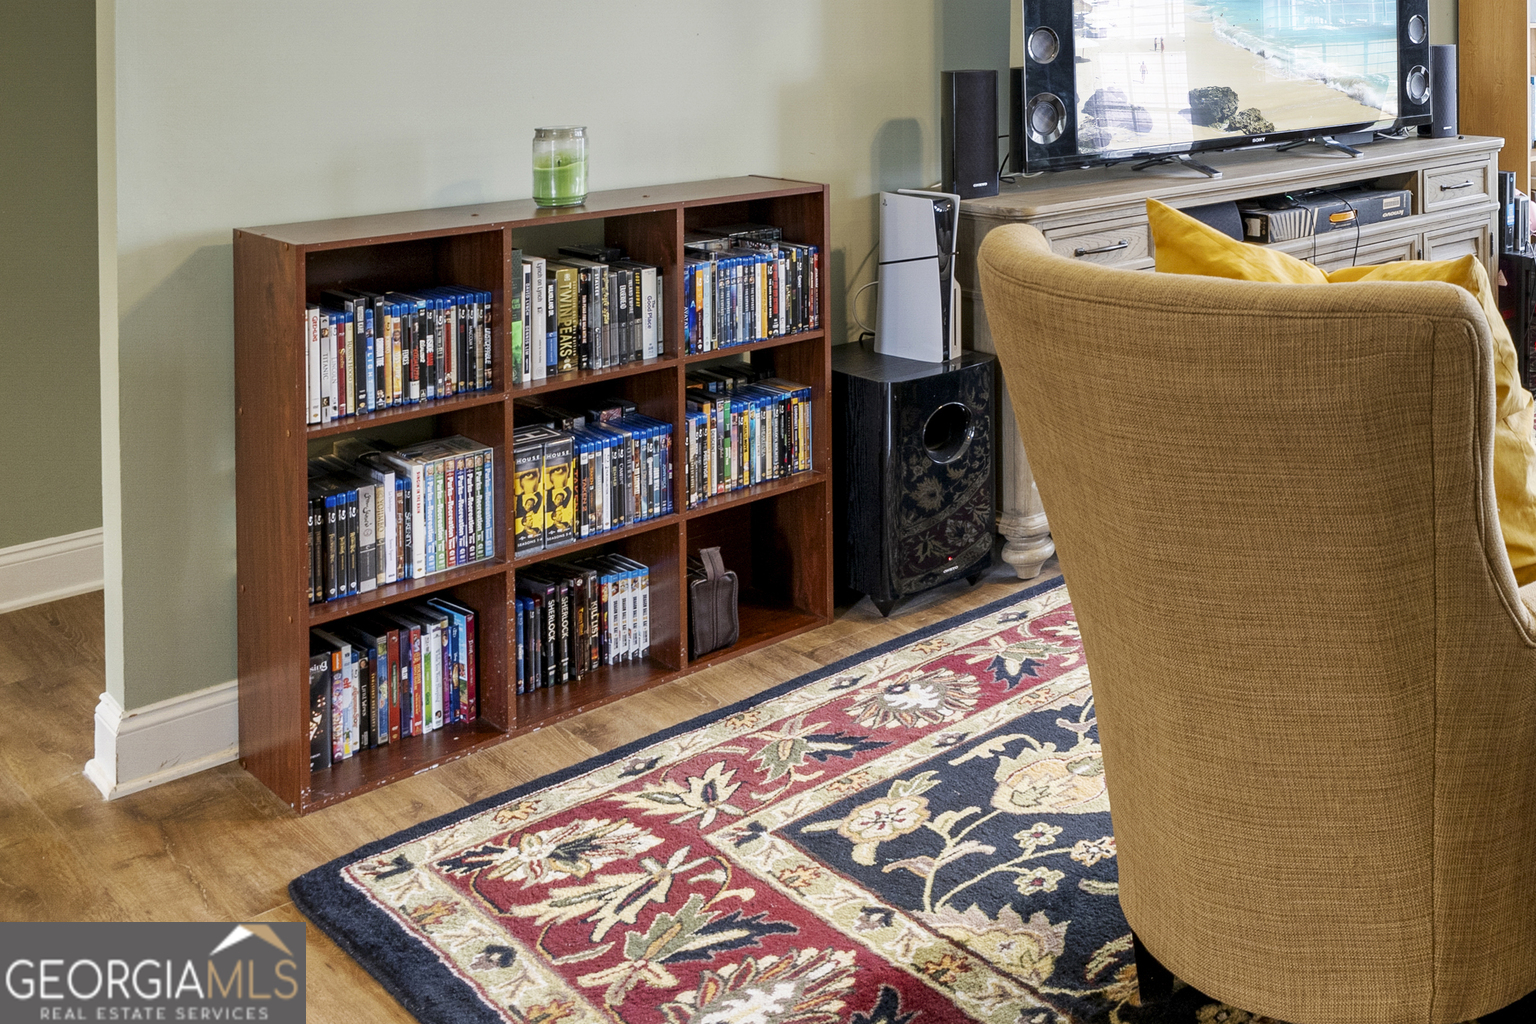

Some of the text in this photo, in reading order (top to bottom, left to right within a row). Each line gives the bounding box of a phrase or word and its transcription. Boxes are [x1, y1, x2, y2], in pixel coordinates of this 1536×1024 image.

[1252, 136, 1266, 144] SONY
[559, 282, 572, 357] TWIN PEAKS
[547, 450, 569, 458] HOUSE
[517, 455, 540, 464] HOUSE
[561, 596, 569, 639] SHERLOCK
